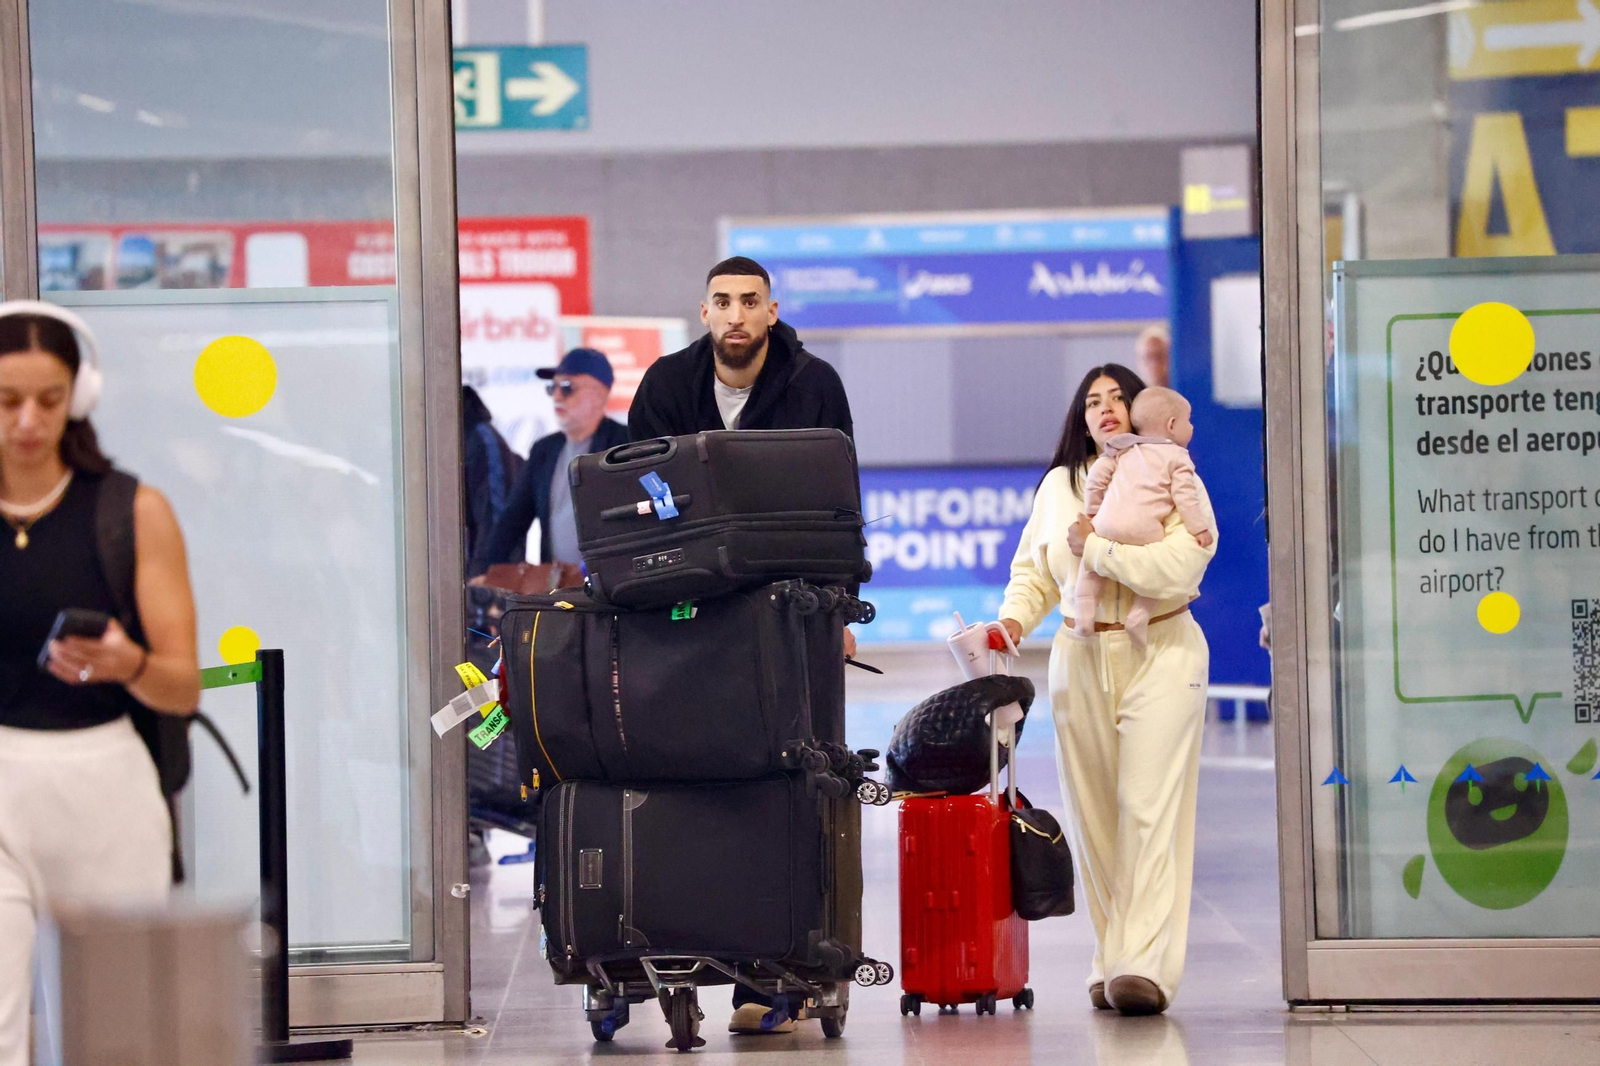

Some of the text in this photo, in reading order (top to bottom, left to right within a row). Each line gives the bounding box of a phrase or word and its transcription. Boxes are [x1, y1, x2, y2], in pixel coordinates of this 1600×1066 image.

[1415, 390, 1546, 419] transporte
[1417, 428, 1600, 456] desde el aerop
[1418, 486, 1588, 515] What transport
[865, 529, 1006, 571] POINT
[1419, 529, 1446, 554] do
[1453, 528, 1458, 552] I
[1466, 527, 1521, 551] have
[1527, 525, 1580, 549] from
[1420, 566, 1505, 598] airport?
